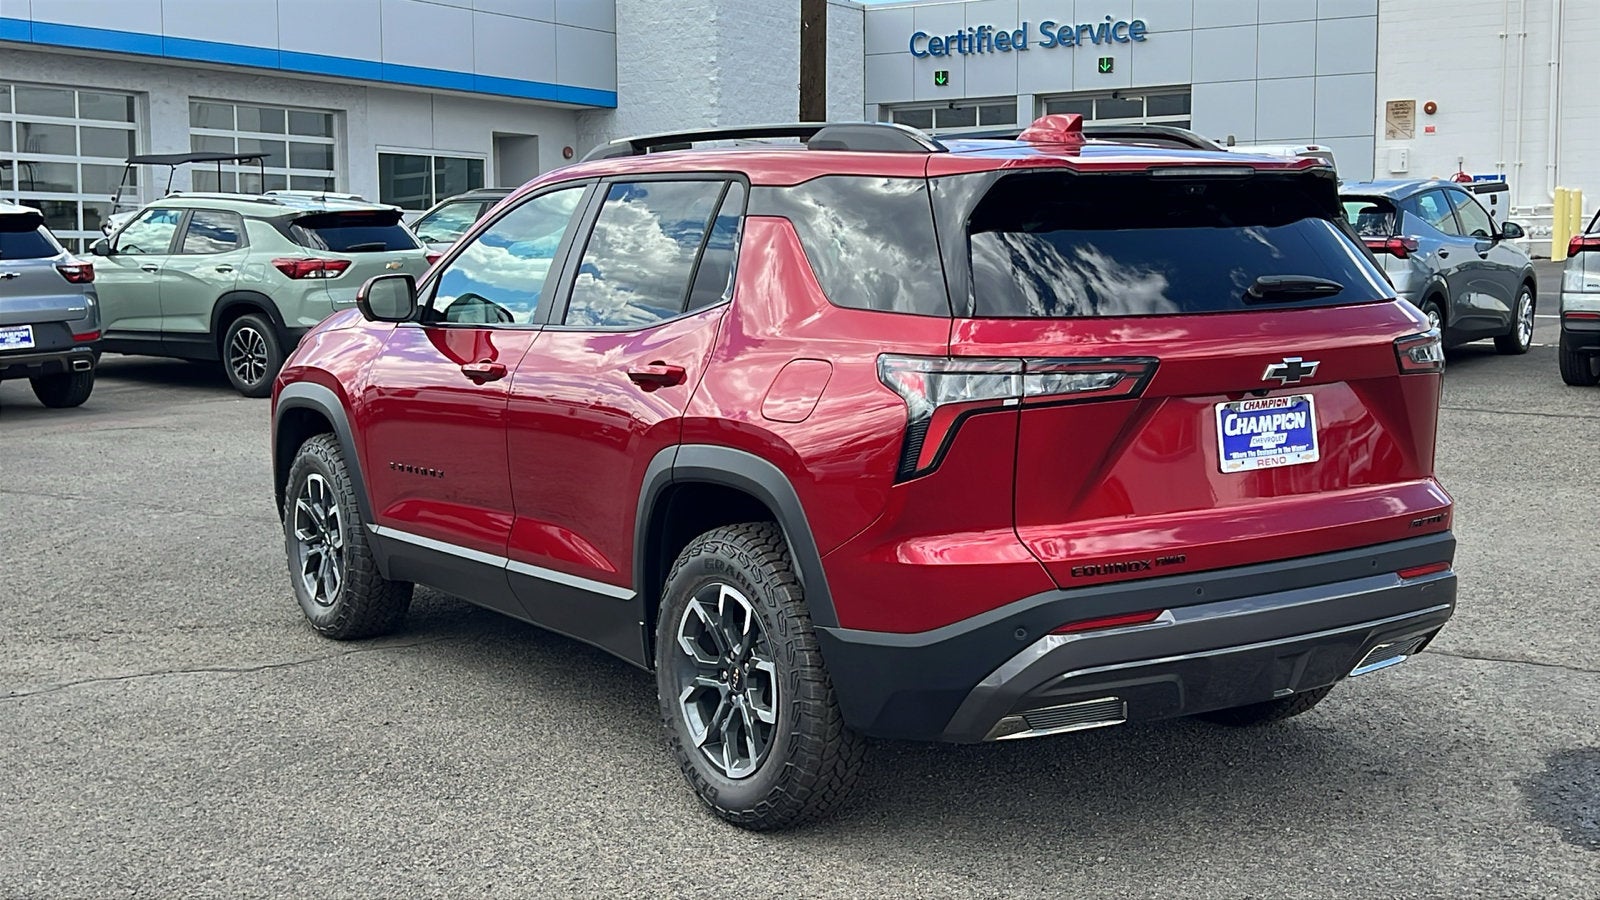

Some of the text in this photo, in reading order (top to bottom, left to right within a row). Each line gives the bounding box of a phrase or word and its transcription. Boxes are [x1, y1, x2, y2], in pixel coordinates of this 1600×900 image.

[910, 15, 1146, 58] Certified Service
[1244, 398, 1288, 411] CHAMPION
[1224, 411, 1306, 437] CHAMPION
[1252, 434, 1284, 445] CHEVROLET
[1257, 456, 1287, 467] RENO
[1071, 560, 1152, 577] EQUINOX
